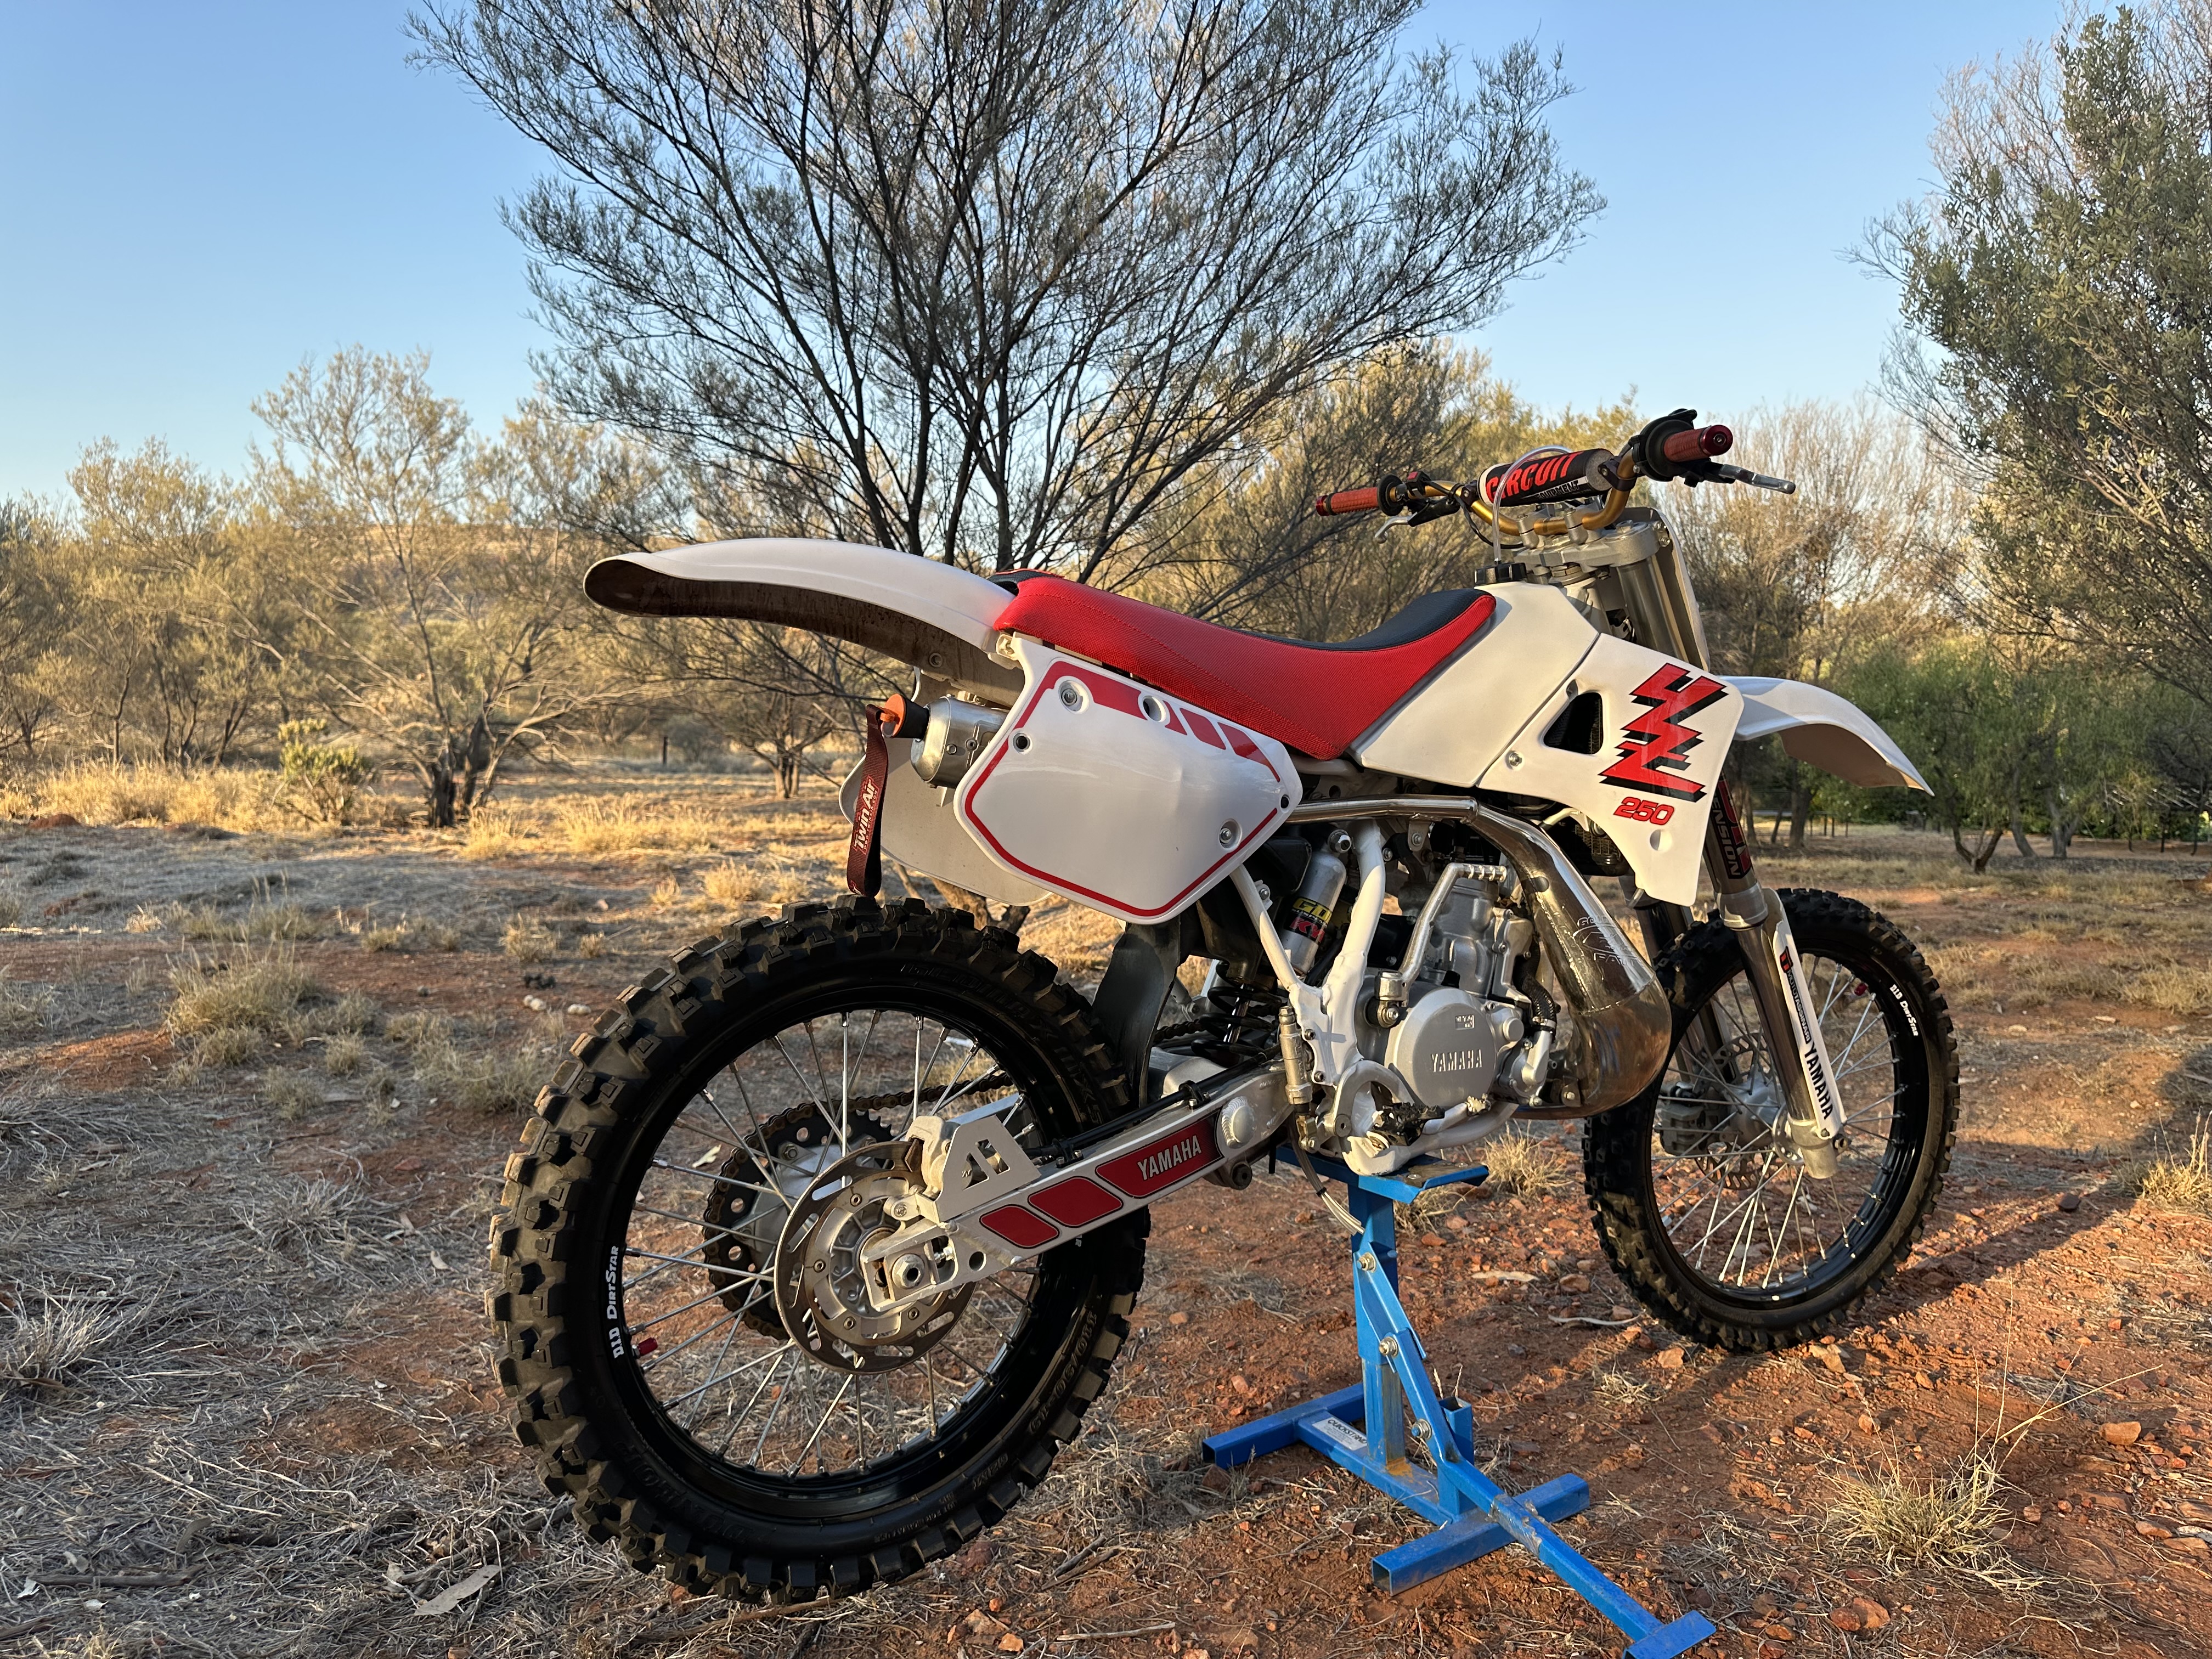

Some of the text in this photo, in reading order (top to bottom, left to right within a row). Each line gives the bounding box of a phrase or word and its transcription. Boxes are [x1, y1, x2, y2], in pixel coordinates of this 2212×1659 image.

[1534, 480, 1579, 499] EQUIPMENT
[854, 778, 875, 849] Twin Air
[1613, 797, 1675, 826] 250
[1787, 969, 1811, 1042] MOTOTASSINARI
[1431, 1049, 1482, 1072] YAMAHA
[1804, 1041, 1833, 1120] YAMAHA
[1137, 1135, 1201, 1181] YAMAHA
